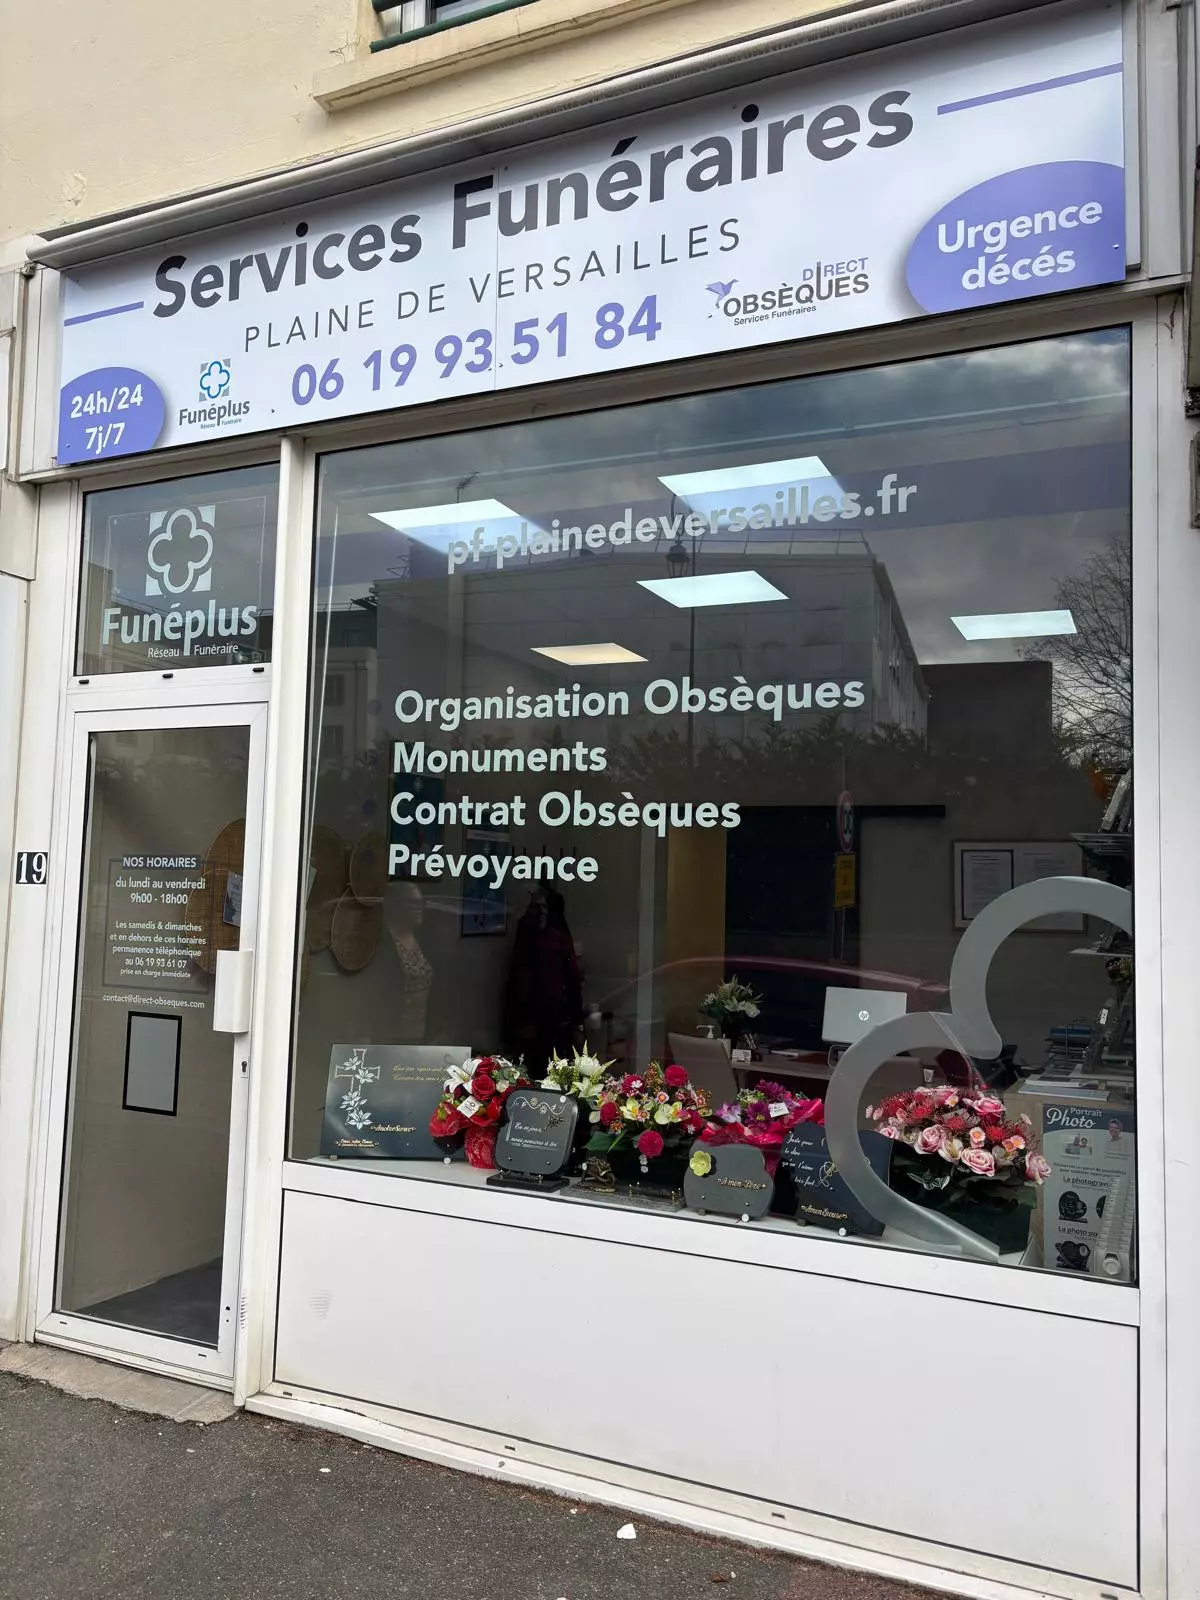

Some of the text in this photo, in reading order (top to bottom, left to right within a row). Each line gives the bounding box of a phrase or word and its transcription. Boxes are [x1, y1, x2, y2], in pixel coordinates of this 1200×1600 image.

[152, 90, 914, 319] Services Funéraires
[937, 200, 1103, 255] Urgence
[802, 257, 869, 281] DIRECT
[961, 244, 1077, 290] décés
[244, 217, 740, 353] PLAINE DE VERSAILLES
[723, 262, 870, 318] OBSÈQUES
[733, 305, 817, 326] Services Funéraires
[291, 294, 662, 406] 06 19 93 51 84
[70, 383, 144, 419] 24h/24
[178, 399, 251, 427] Funéplus
[85, 421, 126, 455] 7j/7
[447, 472, 918, 575] pf-plainedeversailles.fr
[102, 599, 258, 657] Funéplus
[147, 643, 239, 659] Réseau Funéraire
[394, 675, 866, 732] Organisation Obsèques
[392, 740, 608, 774] Monuments
[389, 789, 741, 838] Contrat Obsèques
[18, 852, 47, 884] 19
[123, 856, 197, 868] NOS HORAIRES
[387, 843, 600, 890] Prévoyance
[115, 876, 206, 889] du lundi au vendredi
[130, 892, 153, 903] 9h00
[160, 893, 188, 904] 18h00
[128, 920, 156, 930] samedis
[164, 921, 202, 932] dimanches
[128, 933, 152, 943] dehors
[153, 934, 162, 943] de
[177, 935, 207, 945] horaires
[112, 946, 202, 958] permanence téléphonique
[103, 994, 205, 1009] contact@direct-obseques.com
[1046, 1107, 1097, 1129] Photo
[1070, 1107, 1103, 1117] Portrait
